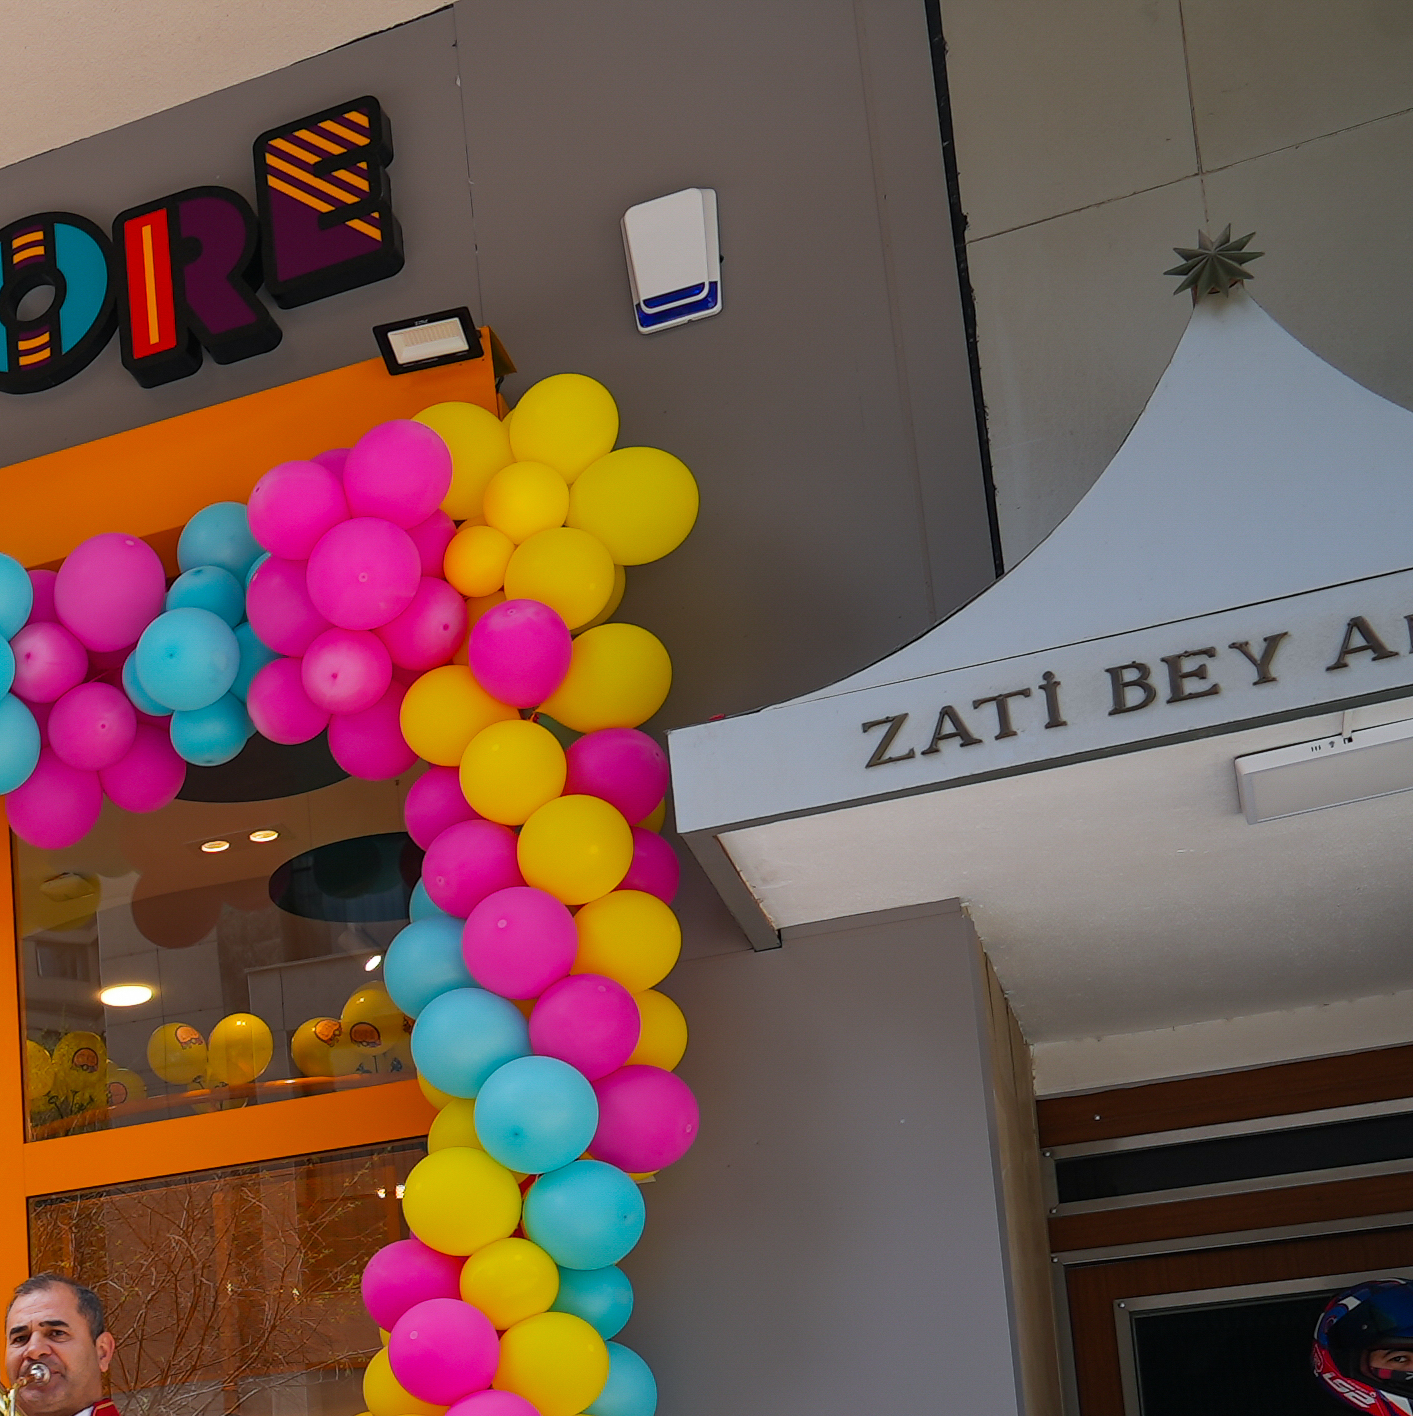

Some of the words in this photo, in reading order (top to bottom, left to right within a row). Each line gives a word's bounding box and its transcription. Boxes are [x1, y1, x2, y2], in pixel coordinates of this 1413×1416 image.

[860, 670, 1069, 770] ZATİ
[1105, 631, 1290, 718] BEY
[1325, 613, 1413, 673] A
[1321, 1371, 1376, 1409] LS2
